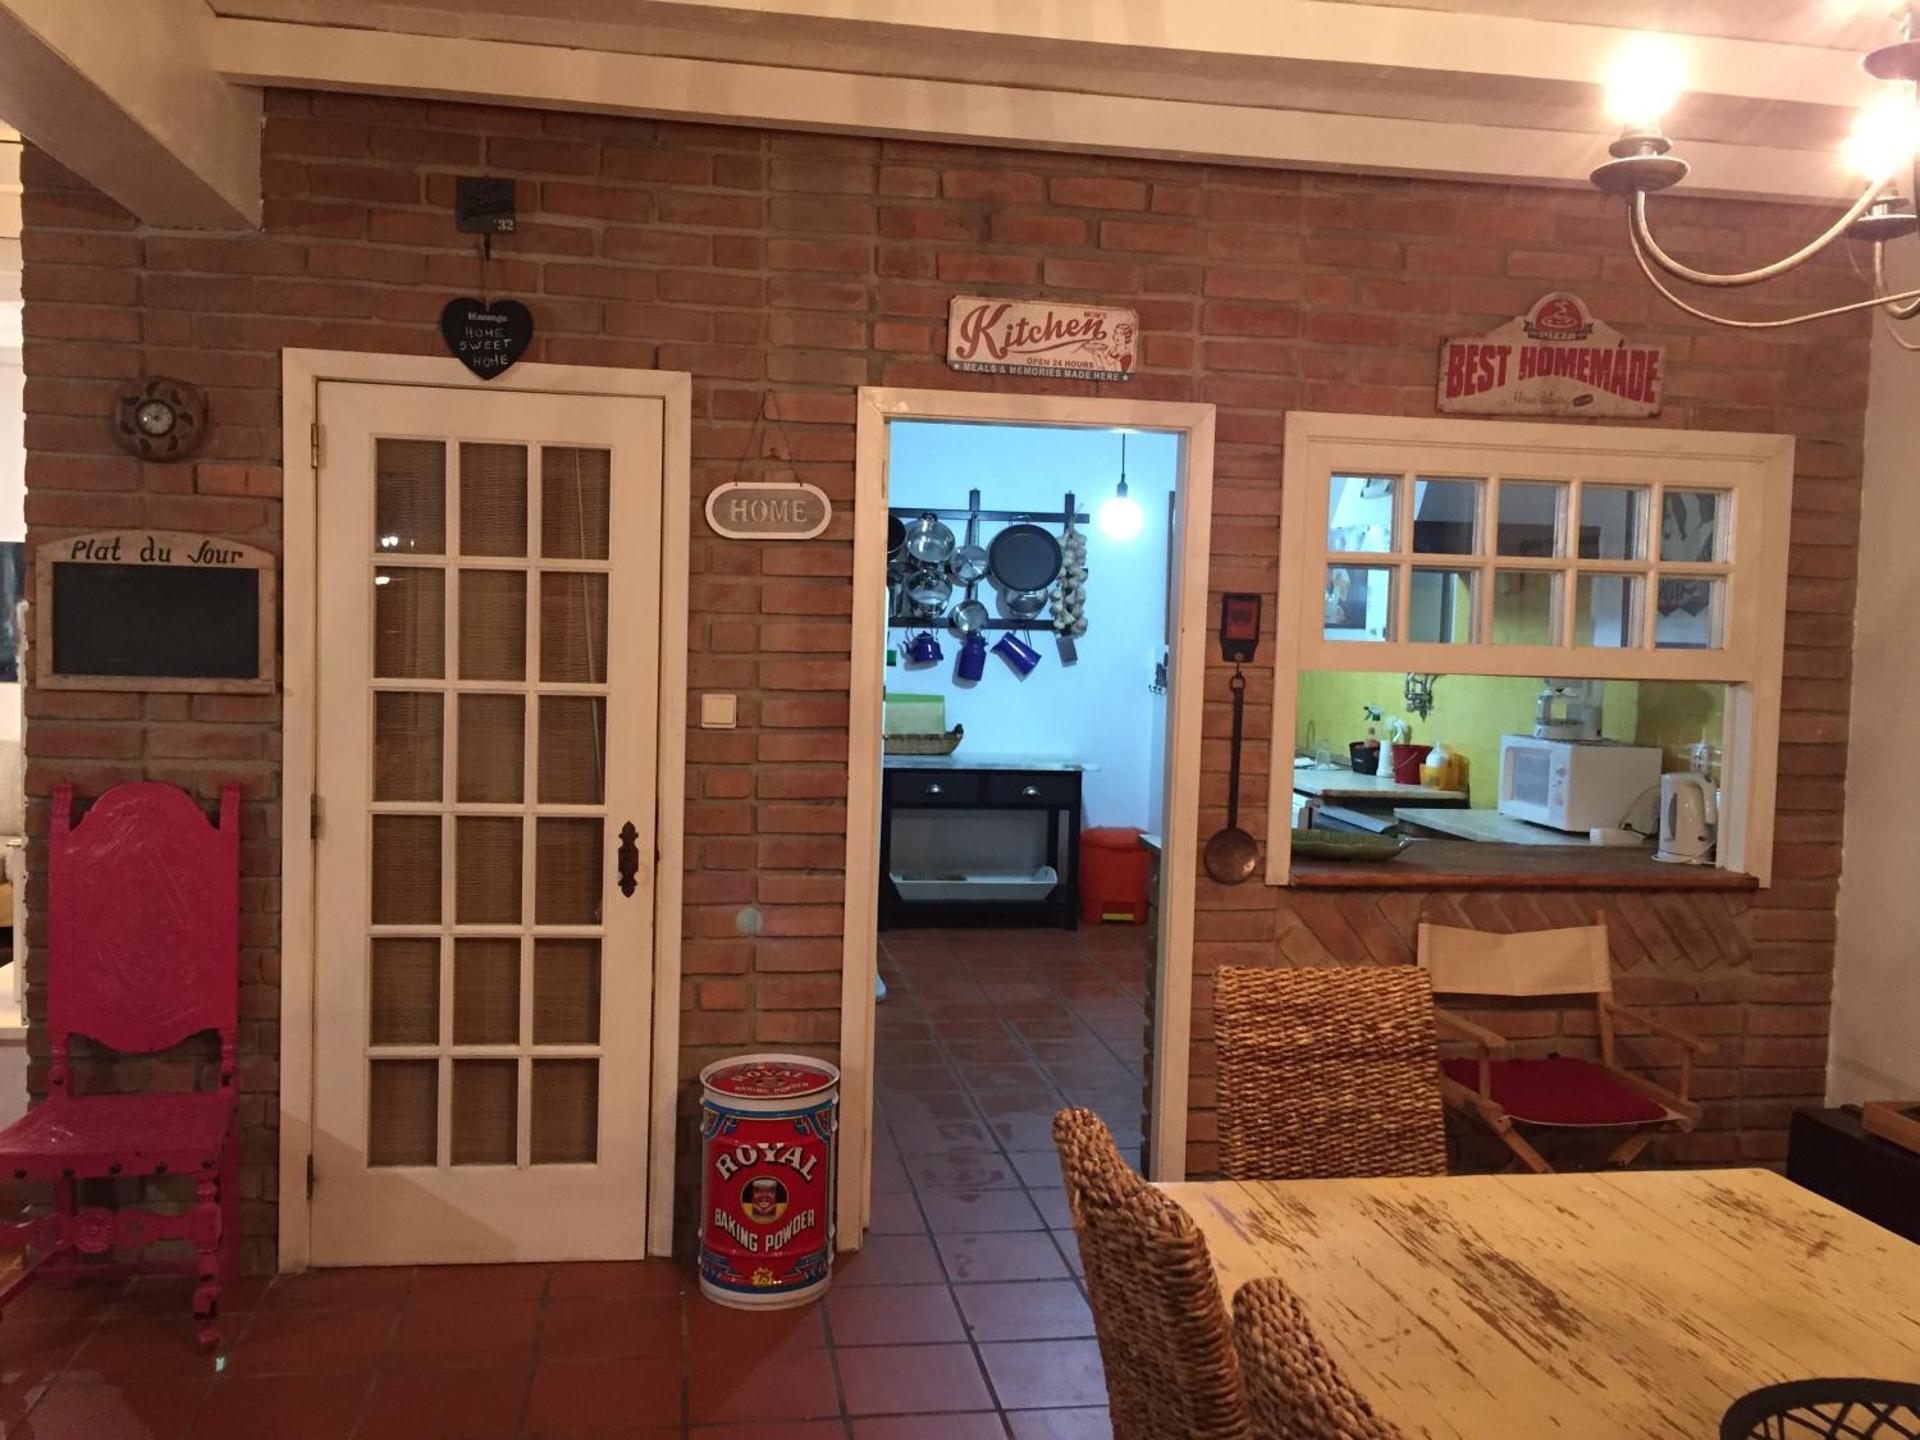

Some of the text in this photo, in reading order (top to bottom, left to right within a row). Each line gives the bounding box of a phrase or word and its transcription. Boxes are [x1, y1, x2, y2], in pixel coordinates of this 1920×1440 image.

[465, 325, 503, 338] HOME
[956, 304, 1107, 360] Kitchen
[460, 338, 512, 351] SWEET
[473, 354, 508, 368] HOME
[963, 363, 1120, 382] MEALS & MEMORIES MADE HERE
[1026, 357, 1094, 369] OPEN 24 HOURS
[1445, 344, 1660, 404] BEST HOMEMADE
[730, 499, 807, 522] HOME
[70, 535, 244, 564] Plat du Jour
[716, 1142, 817, 1181] ROYAL
[714, 1208, 815, 1253] BAKING POWDER
